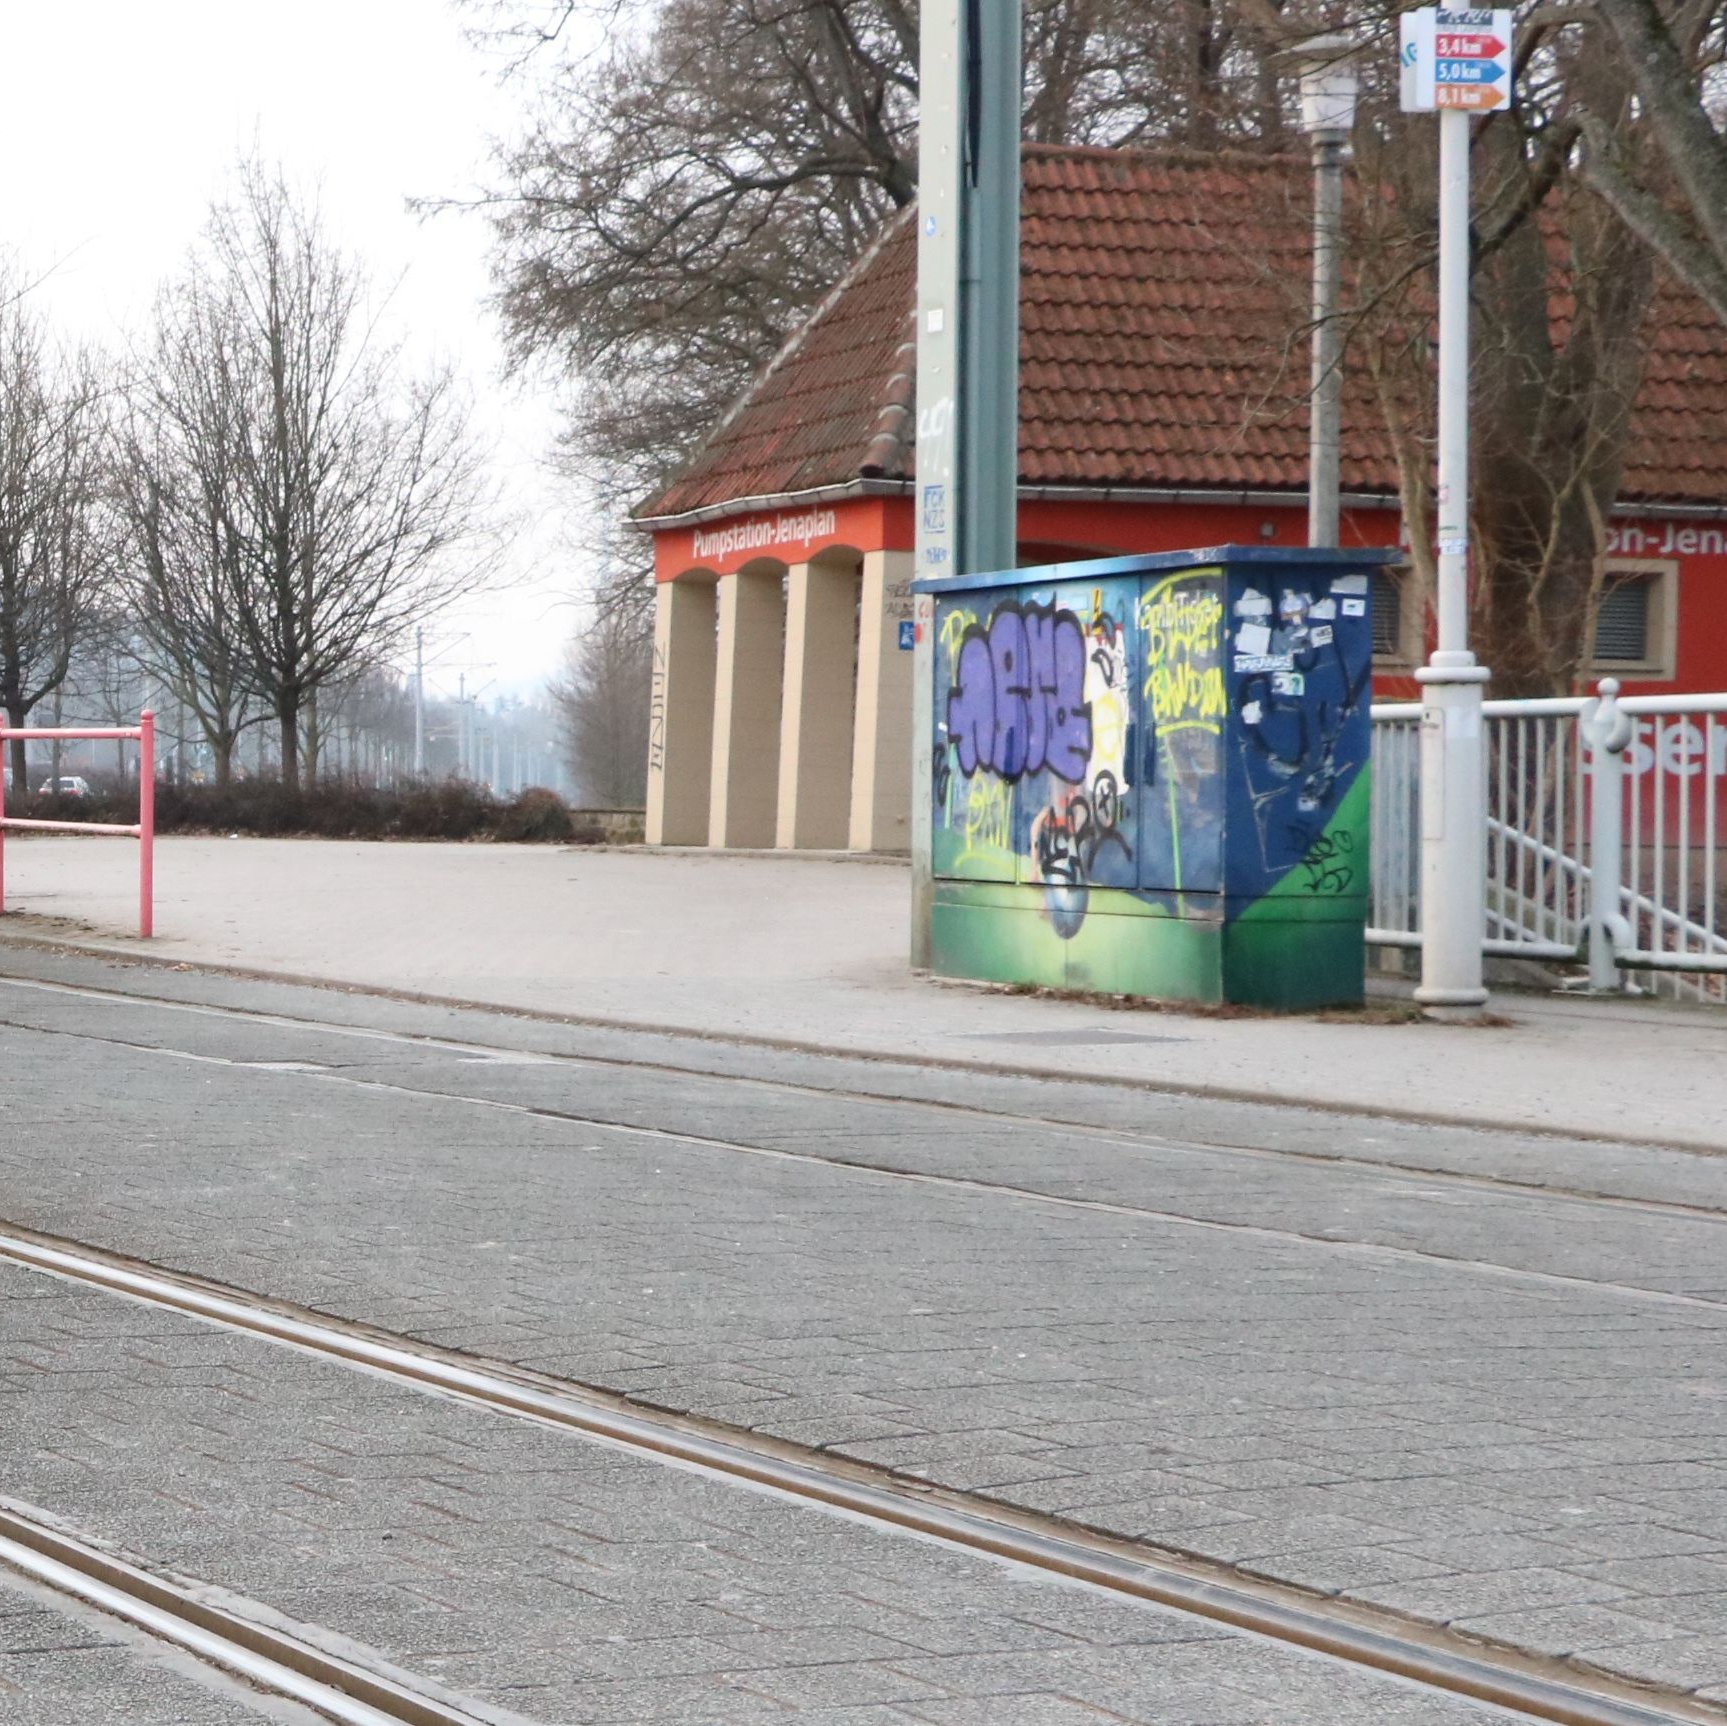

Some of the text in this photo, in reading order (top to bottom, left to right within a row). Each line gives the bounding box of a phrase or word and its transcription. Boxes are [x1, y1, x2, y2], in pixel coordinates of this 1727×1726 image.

[1438, 36, 1482, 56] 3,4 km
[1438, 61, 1482, 80] 5,0 km
[1460, 86, 1481, 104] km
[692, 507, 836, 562] Pumpstation-Jenaplan
